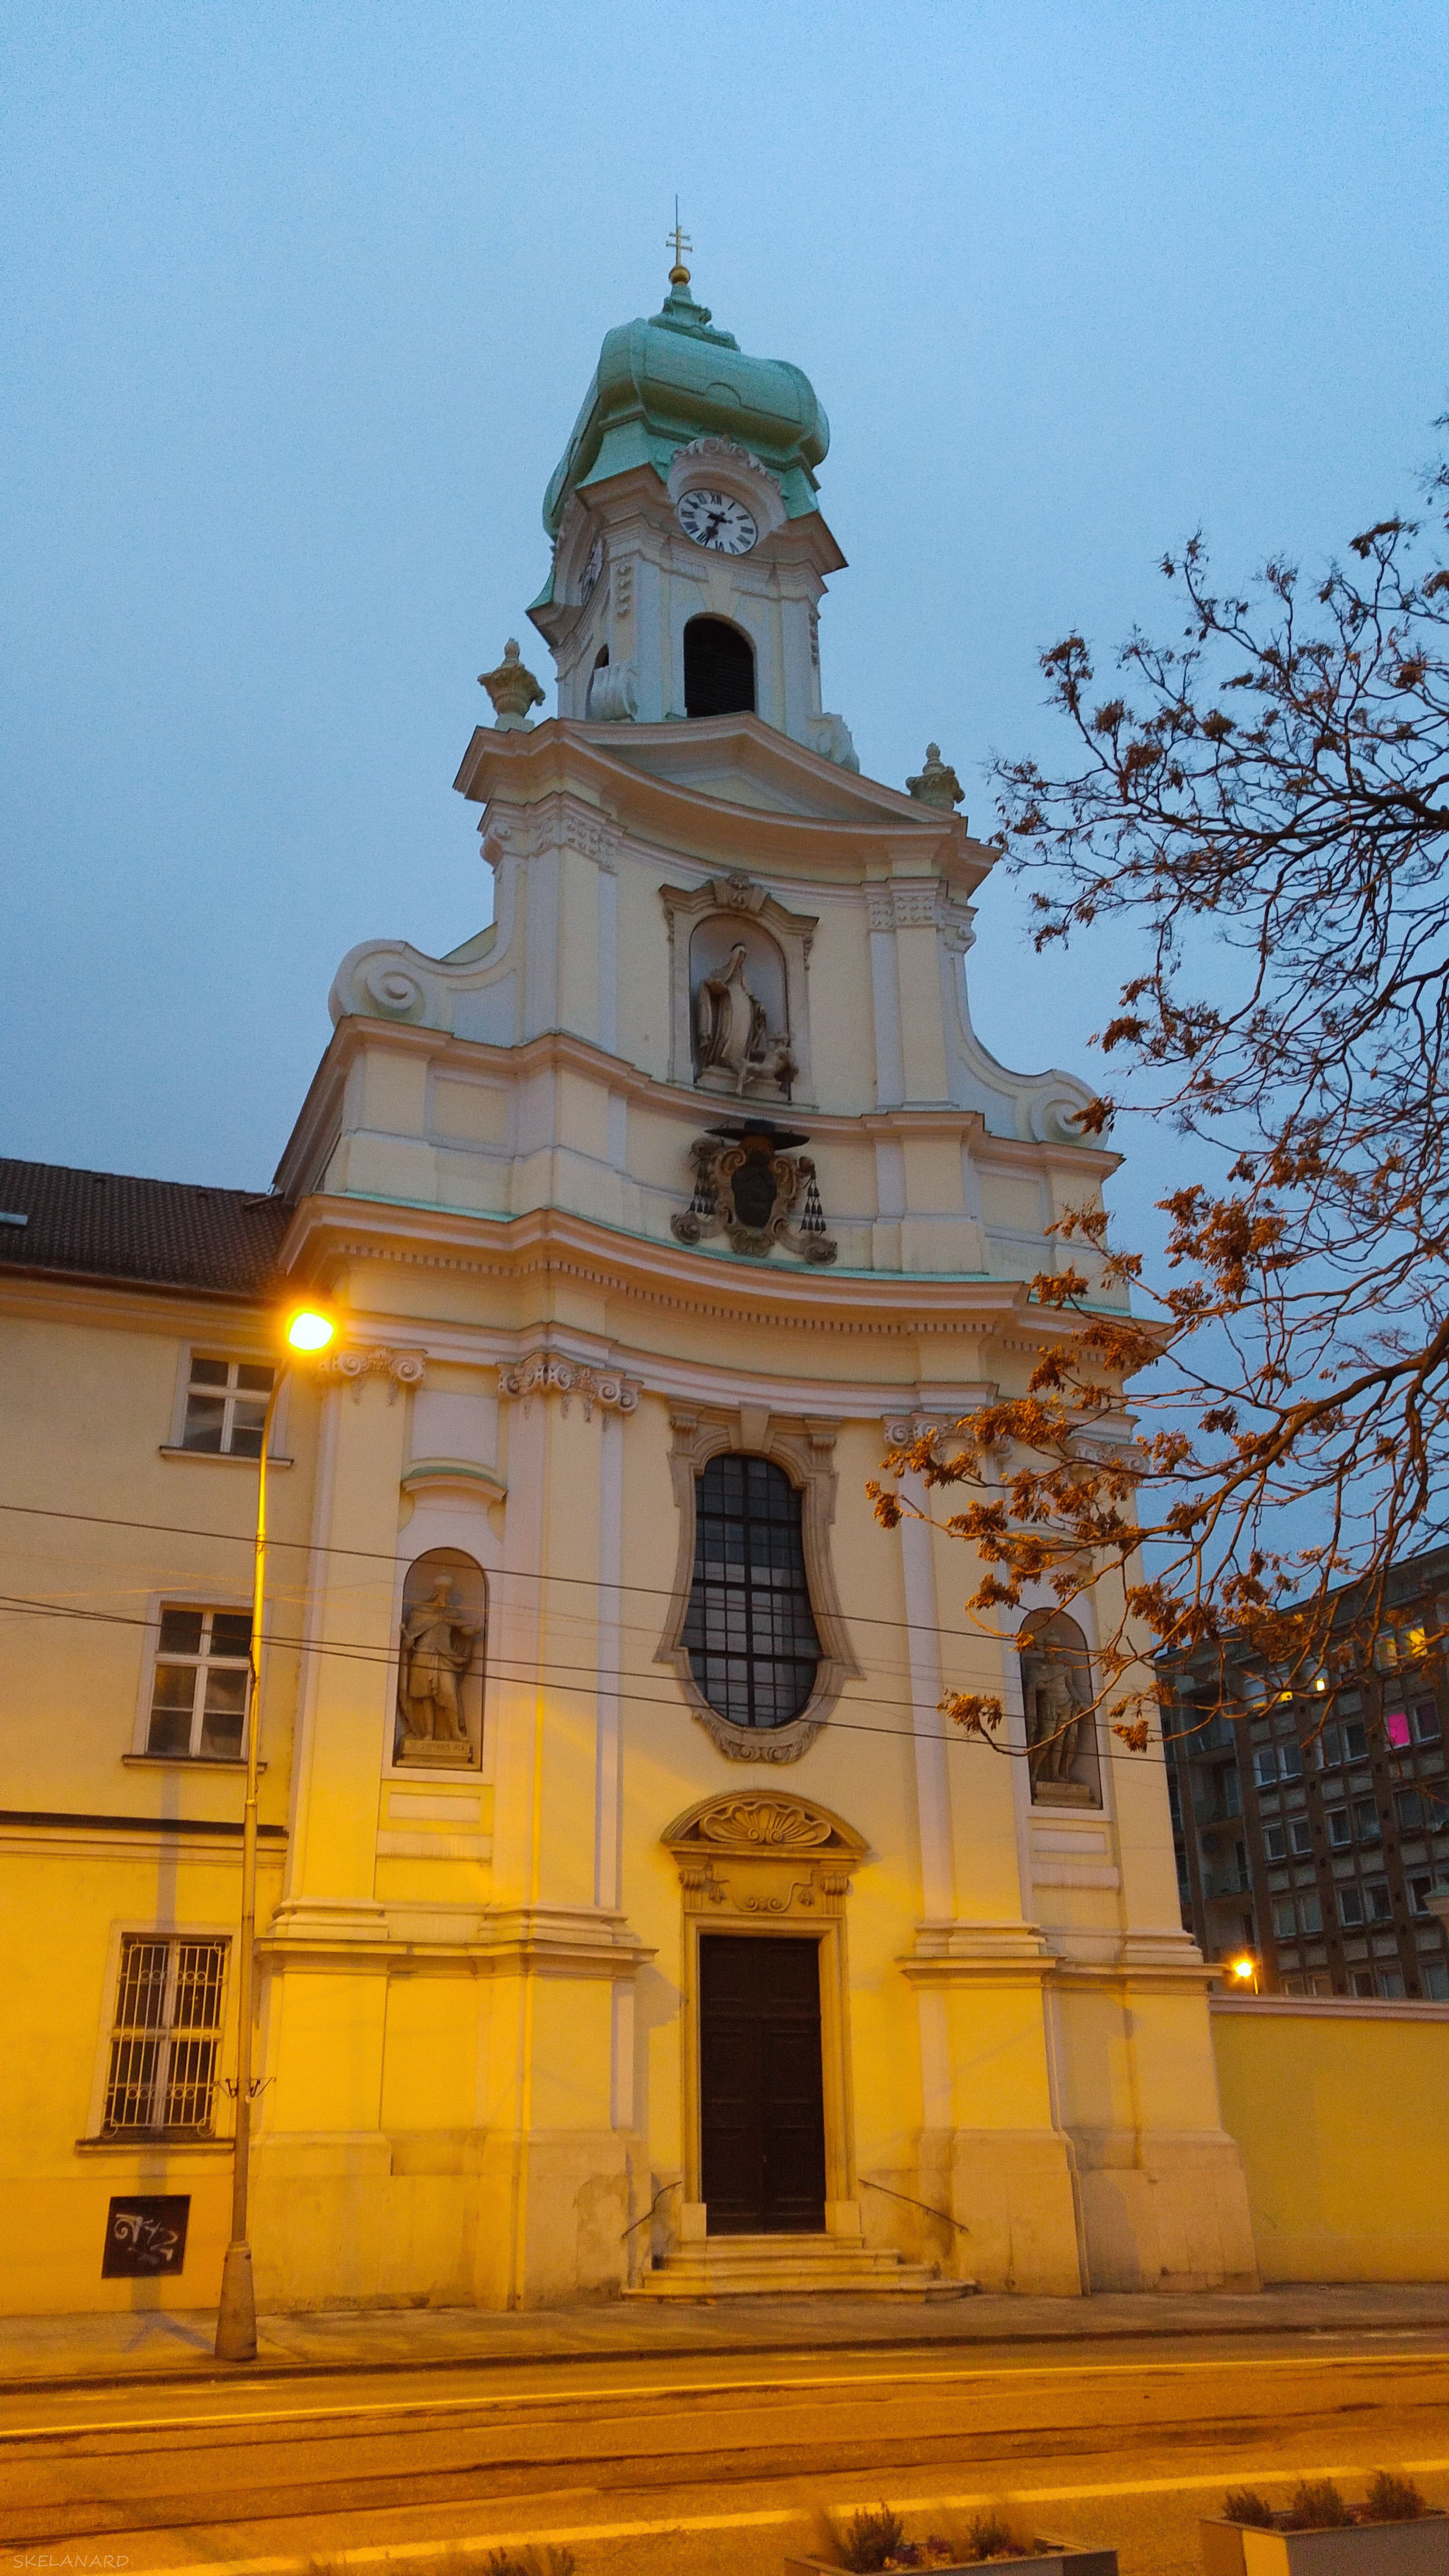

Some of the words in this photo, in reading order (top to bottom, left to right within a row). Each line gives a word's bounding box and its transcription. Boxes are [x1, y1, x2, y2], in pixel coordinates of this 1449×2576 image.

[709, 492, 722, 505] XII
[728, 502, 736, 510] I
[715, 540, 724, 551] VI
[729, 541, 740, 553] V
